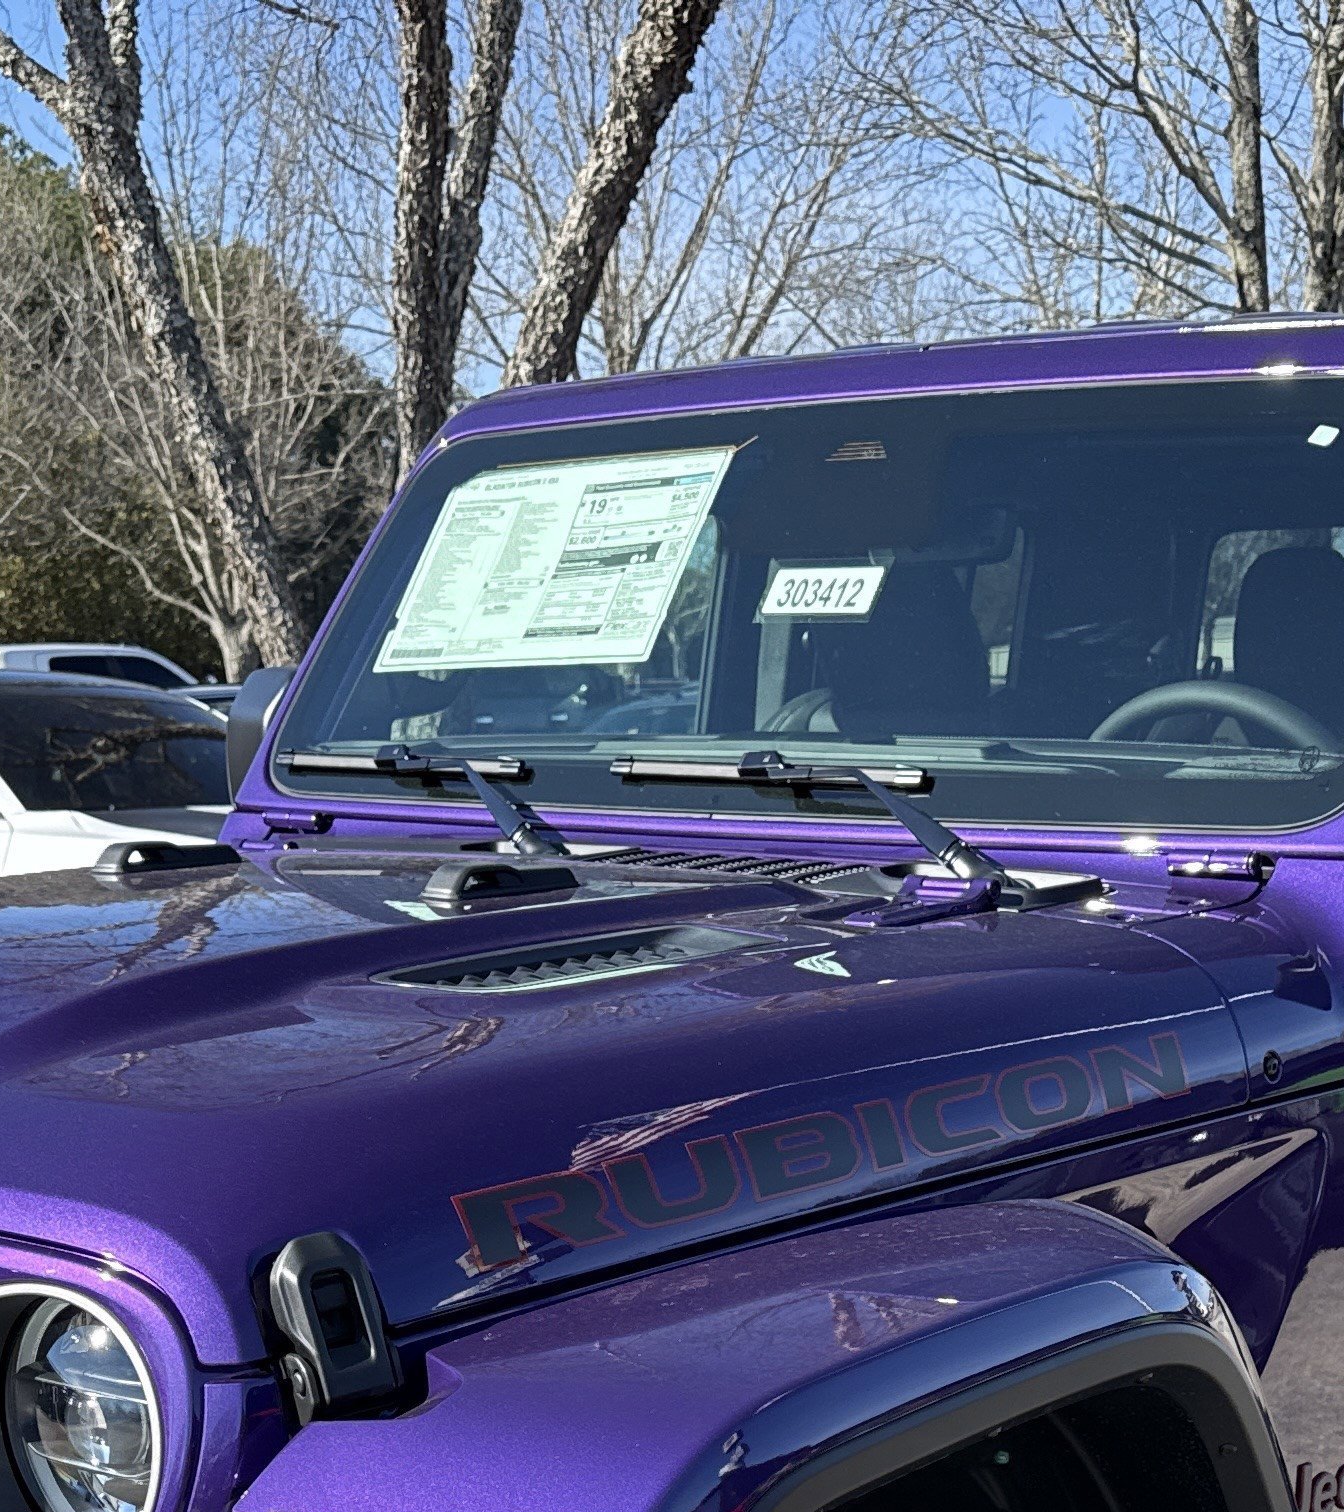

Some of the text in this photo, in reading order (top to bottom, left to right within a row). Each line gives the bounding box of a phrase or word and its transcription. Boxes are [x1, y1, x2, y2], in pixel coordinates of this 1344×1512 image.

[588, 498, 608, 515] 19
[775, 576, 865, 610] 303412
[449, 1030, 1192, 1275] RUBICON
